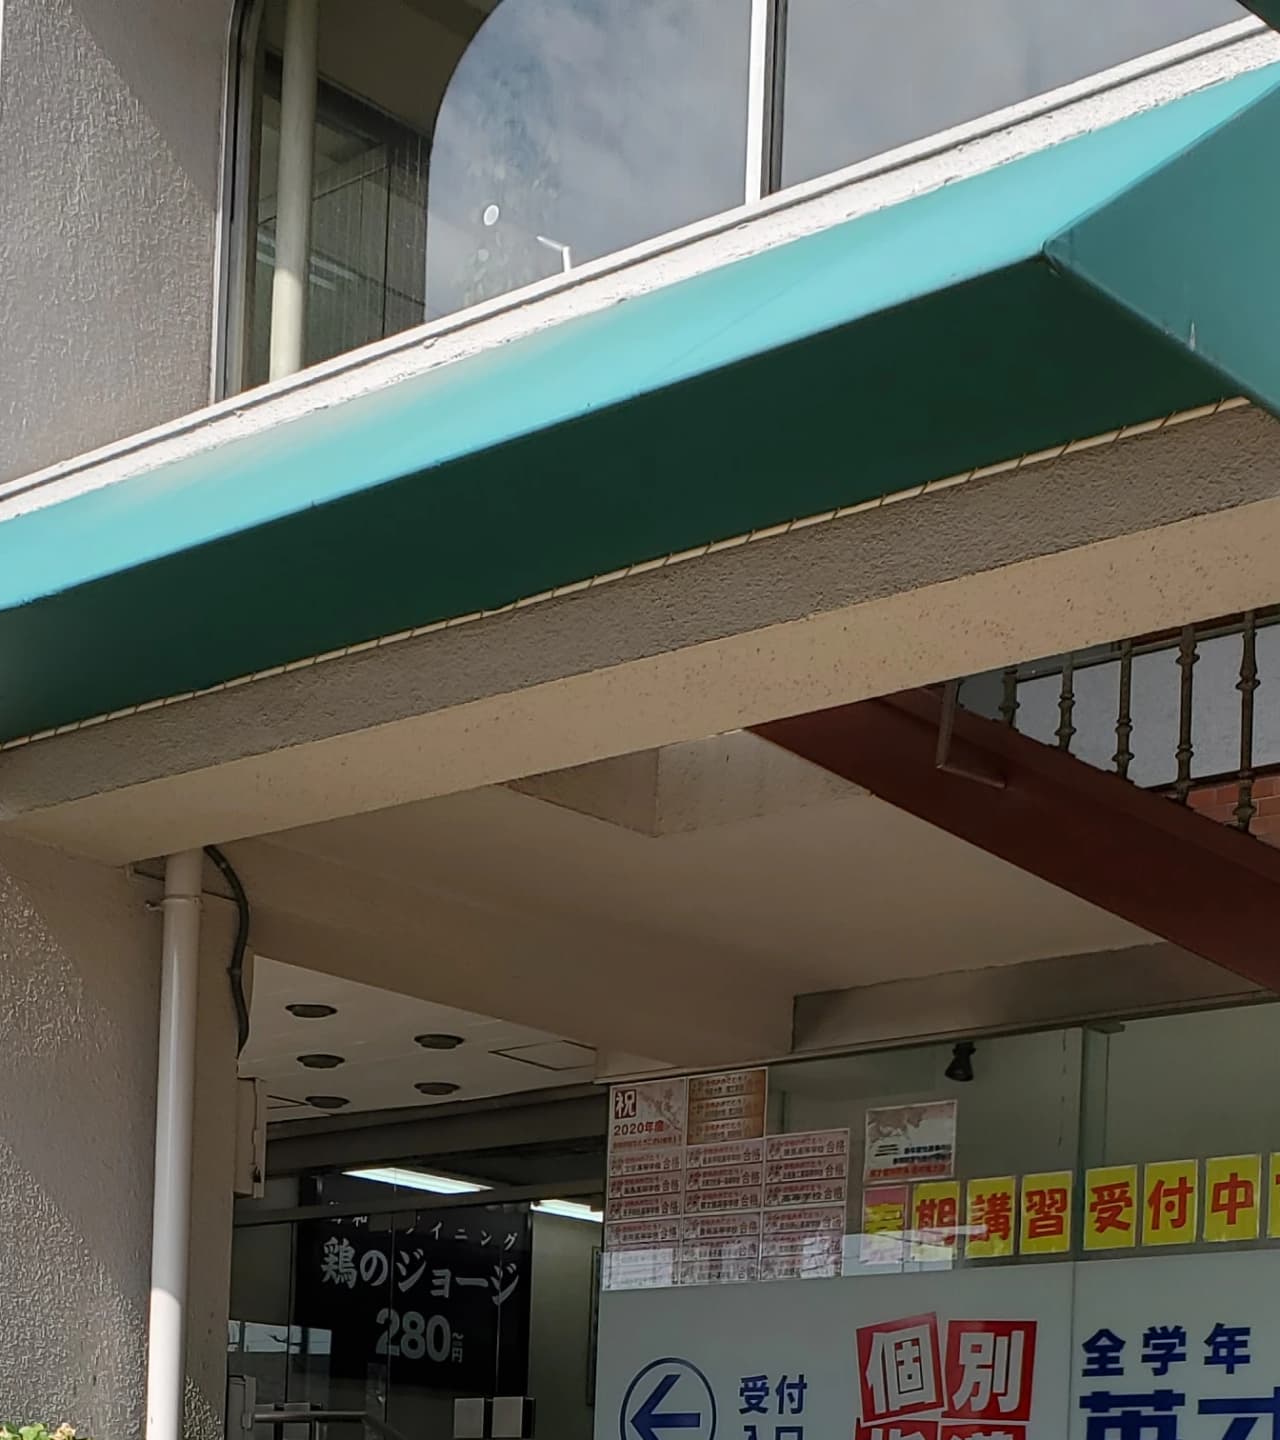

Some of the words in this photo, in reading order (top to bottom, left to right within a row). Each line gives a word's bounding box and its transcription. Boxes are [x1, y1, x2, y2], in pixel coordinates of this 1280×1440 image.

[613, 1120, 665, 1136] 2020年度
[615, 1089, 637, 1120] 祝
[320, 1236, 520, 1305] 鶏のジョージ
[375, 1307, 452, 1363] 280
[1081, 1322, 1252, 1377] 全学年
[738, 1374, 808, 1415] 受付
[866, 1323, 1025, 1415] 個別
